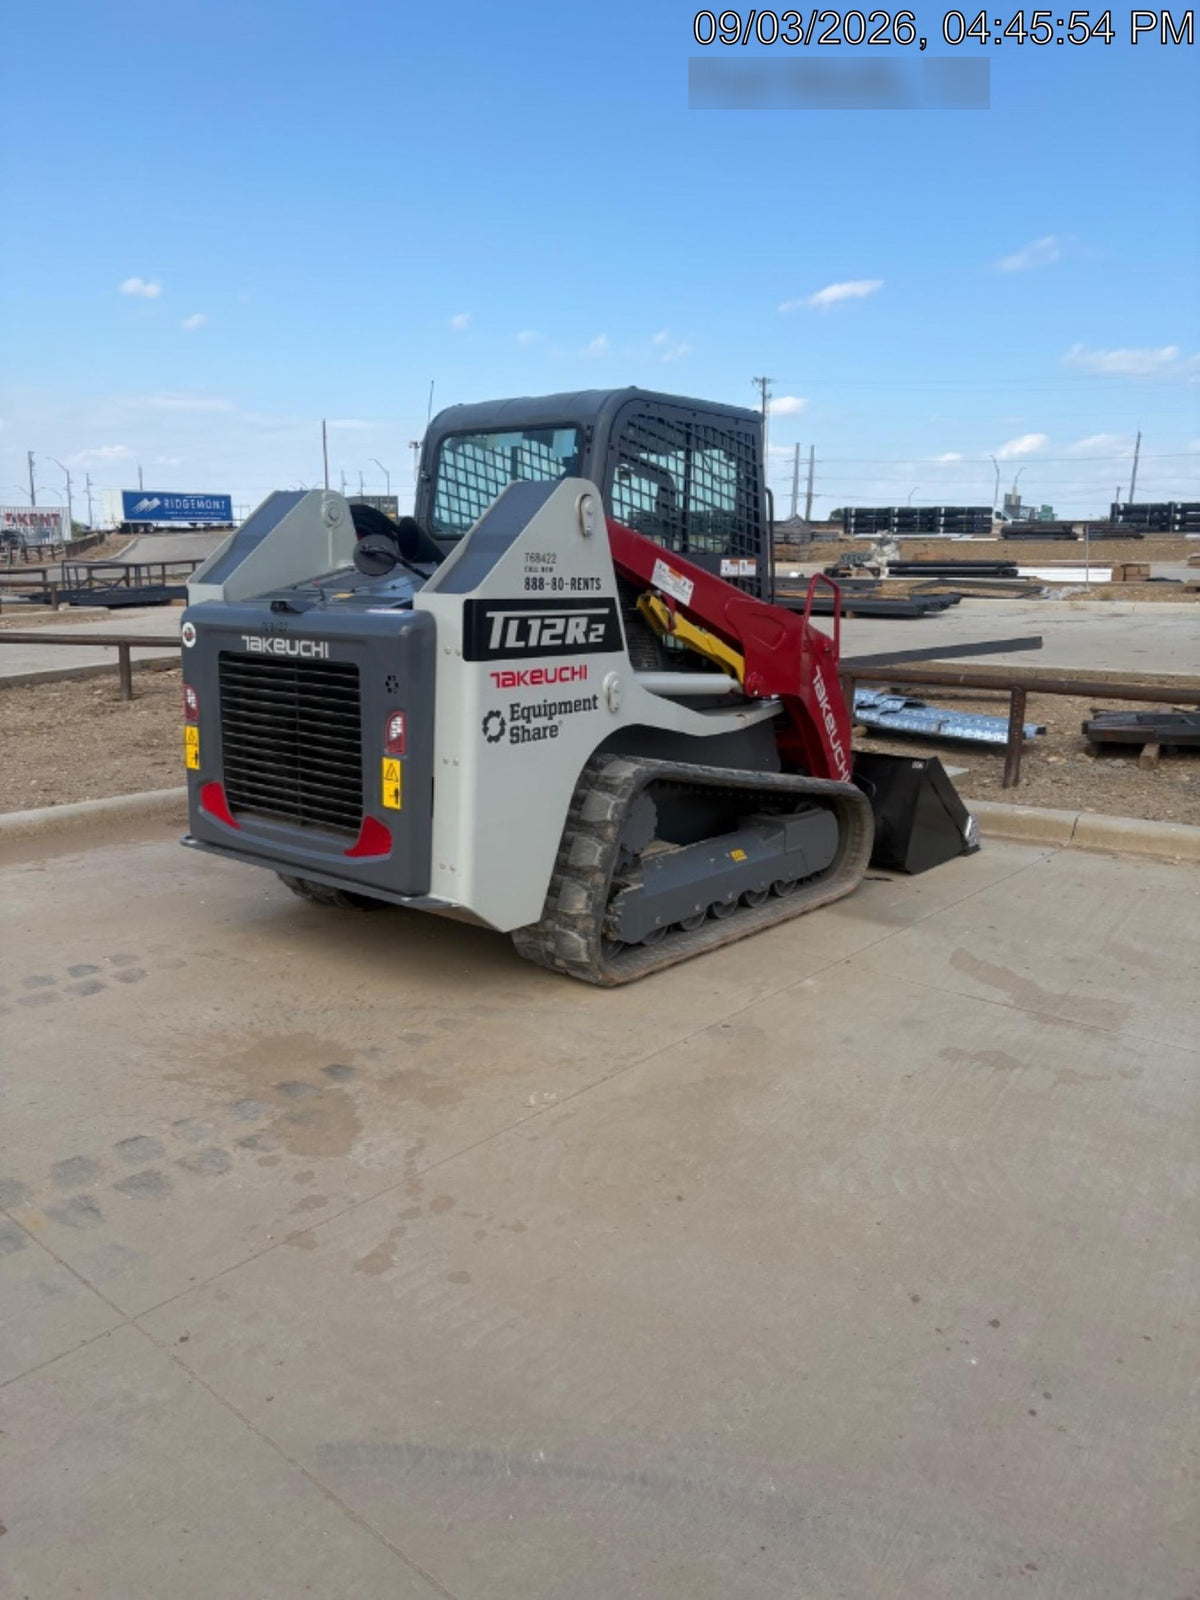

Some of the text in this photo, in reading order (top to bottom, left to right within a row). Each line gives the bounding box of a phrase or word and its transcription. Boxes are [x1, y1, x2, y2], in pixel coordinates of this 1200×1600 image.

[164, 498, 225, 510] RIDGEMONT
[524, 552, 557, 564] 768422
[524, 577, 602, 591] 888-80-RENTS
[486, 608, 610, 650] TL12R2
[509, 694, 598, 724] Equipment
[509, 724, 559, 745] Share
